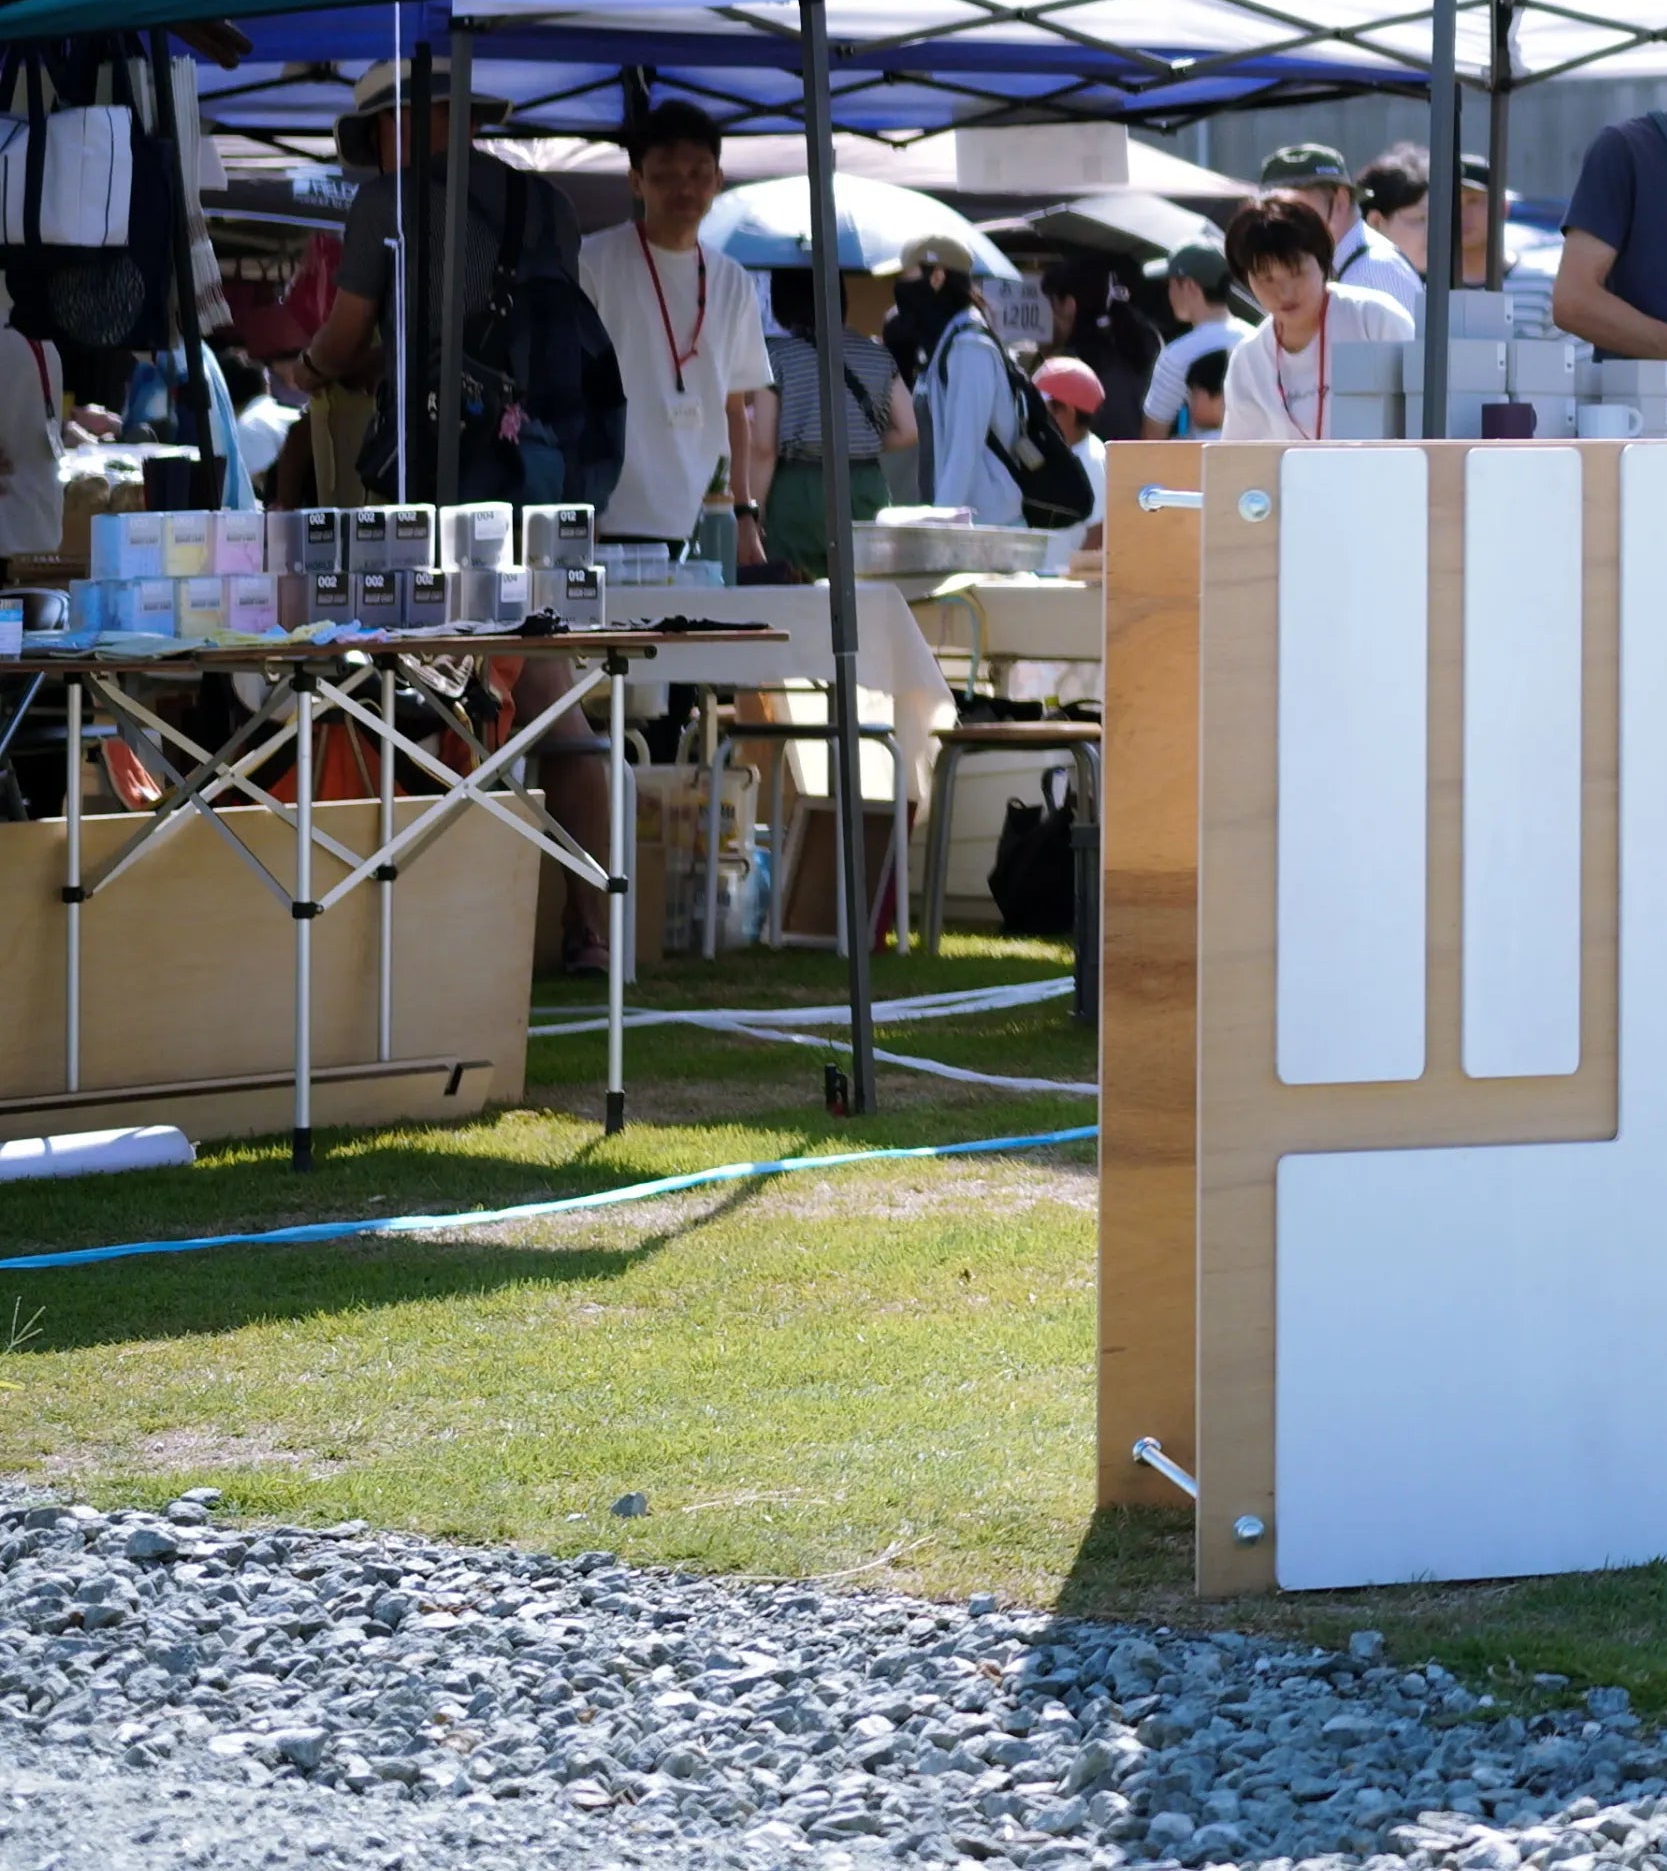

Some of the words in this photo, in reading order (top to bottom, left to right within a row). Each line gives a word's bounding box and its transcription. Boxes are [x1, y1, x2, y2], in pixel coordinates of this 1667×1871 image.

[309, 512, 326, 525] 002
[357, 511, 376, 524] 002
[317, 575, 337, 588] 002
[365, 575, 384, 588] 002
